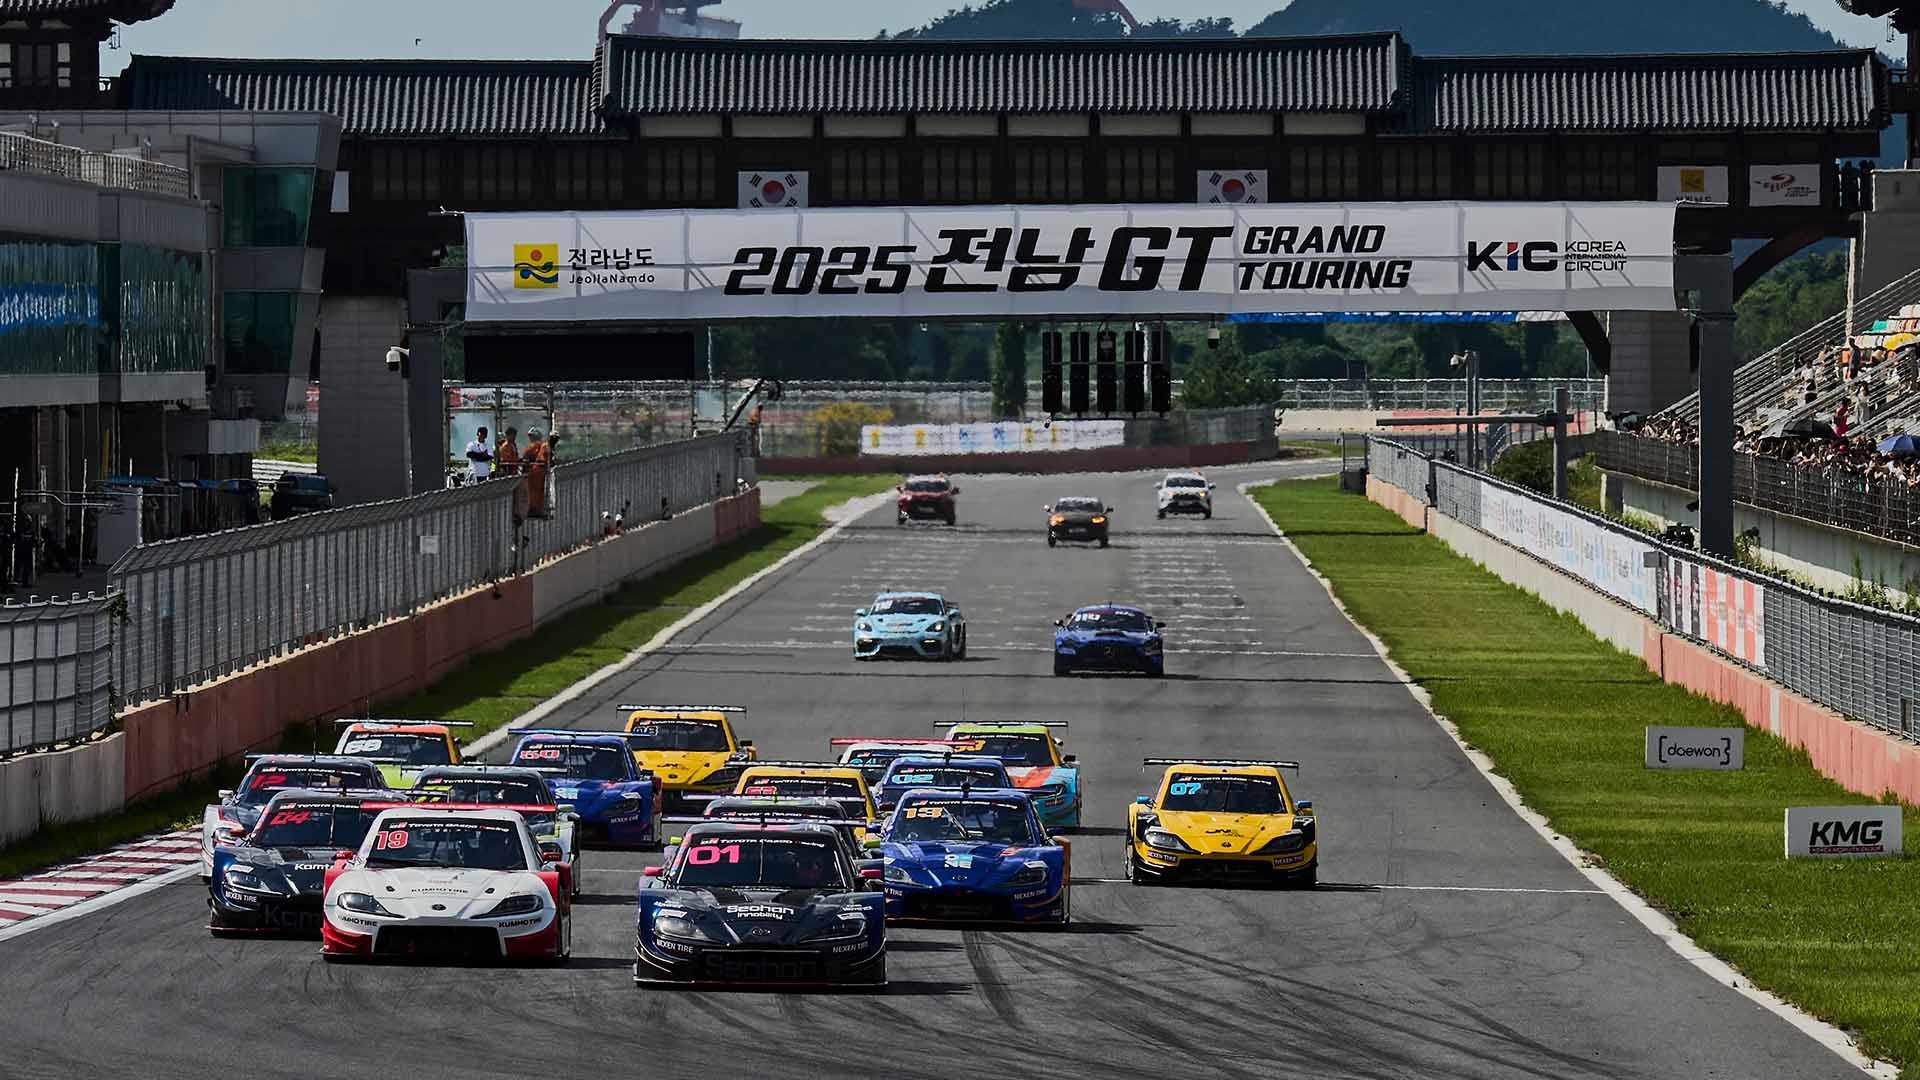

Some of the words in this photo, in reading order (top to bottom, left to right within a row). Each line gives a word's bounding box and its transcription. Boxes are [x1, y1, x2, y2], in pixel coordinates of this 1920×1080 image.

[1242, 225, 1386, 254] GRAND
[1565, 241, 1626, 252] KOREA
[568, 247, 655, 270] 전라남도
[723, 246, 918, 295] 2025
[923, 227, 1096, 293] 전남
[1097, 226, 1235, 291] GT
[1565, 261, 1627, 272] CIRCUIT
[569, 273, 655, 284] JeollaNamdo
[1238, 260, 1413, 290] TOURING
[892, 774, 934, 784] 02
[1170, 783, 1201, 795] 07
[903, 807, 942, 818] 13
[376, 831, 408, 850] 19
[1809, 821, 1883, 845] KMG
[689, 845, 740, 865] 01
[727, 905, 794, 915] Seohan
